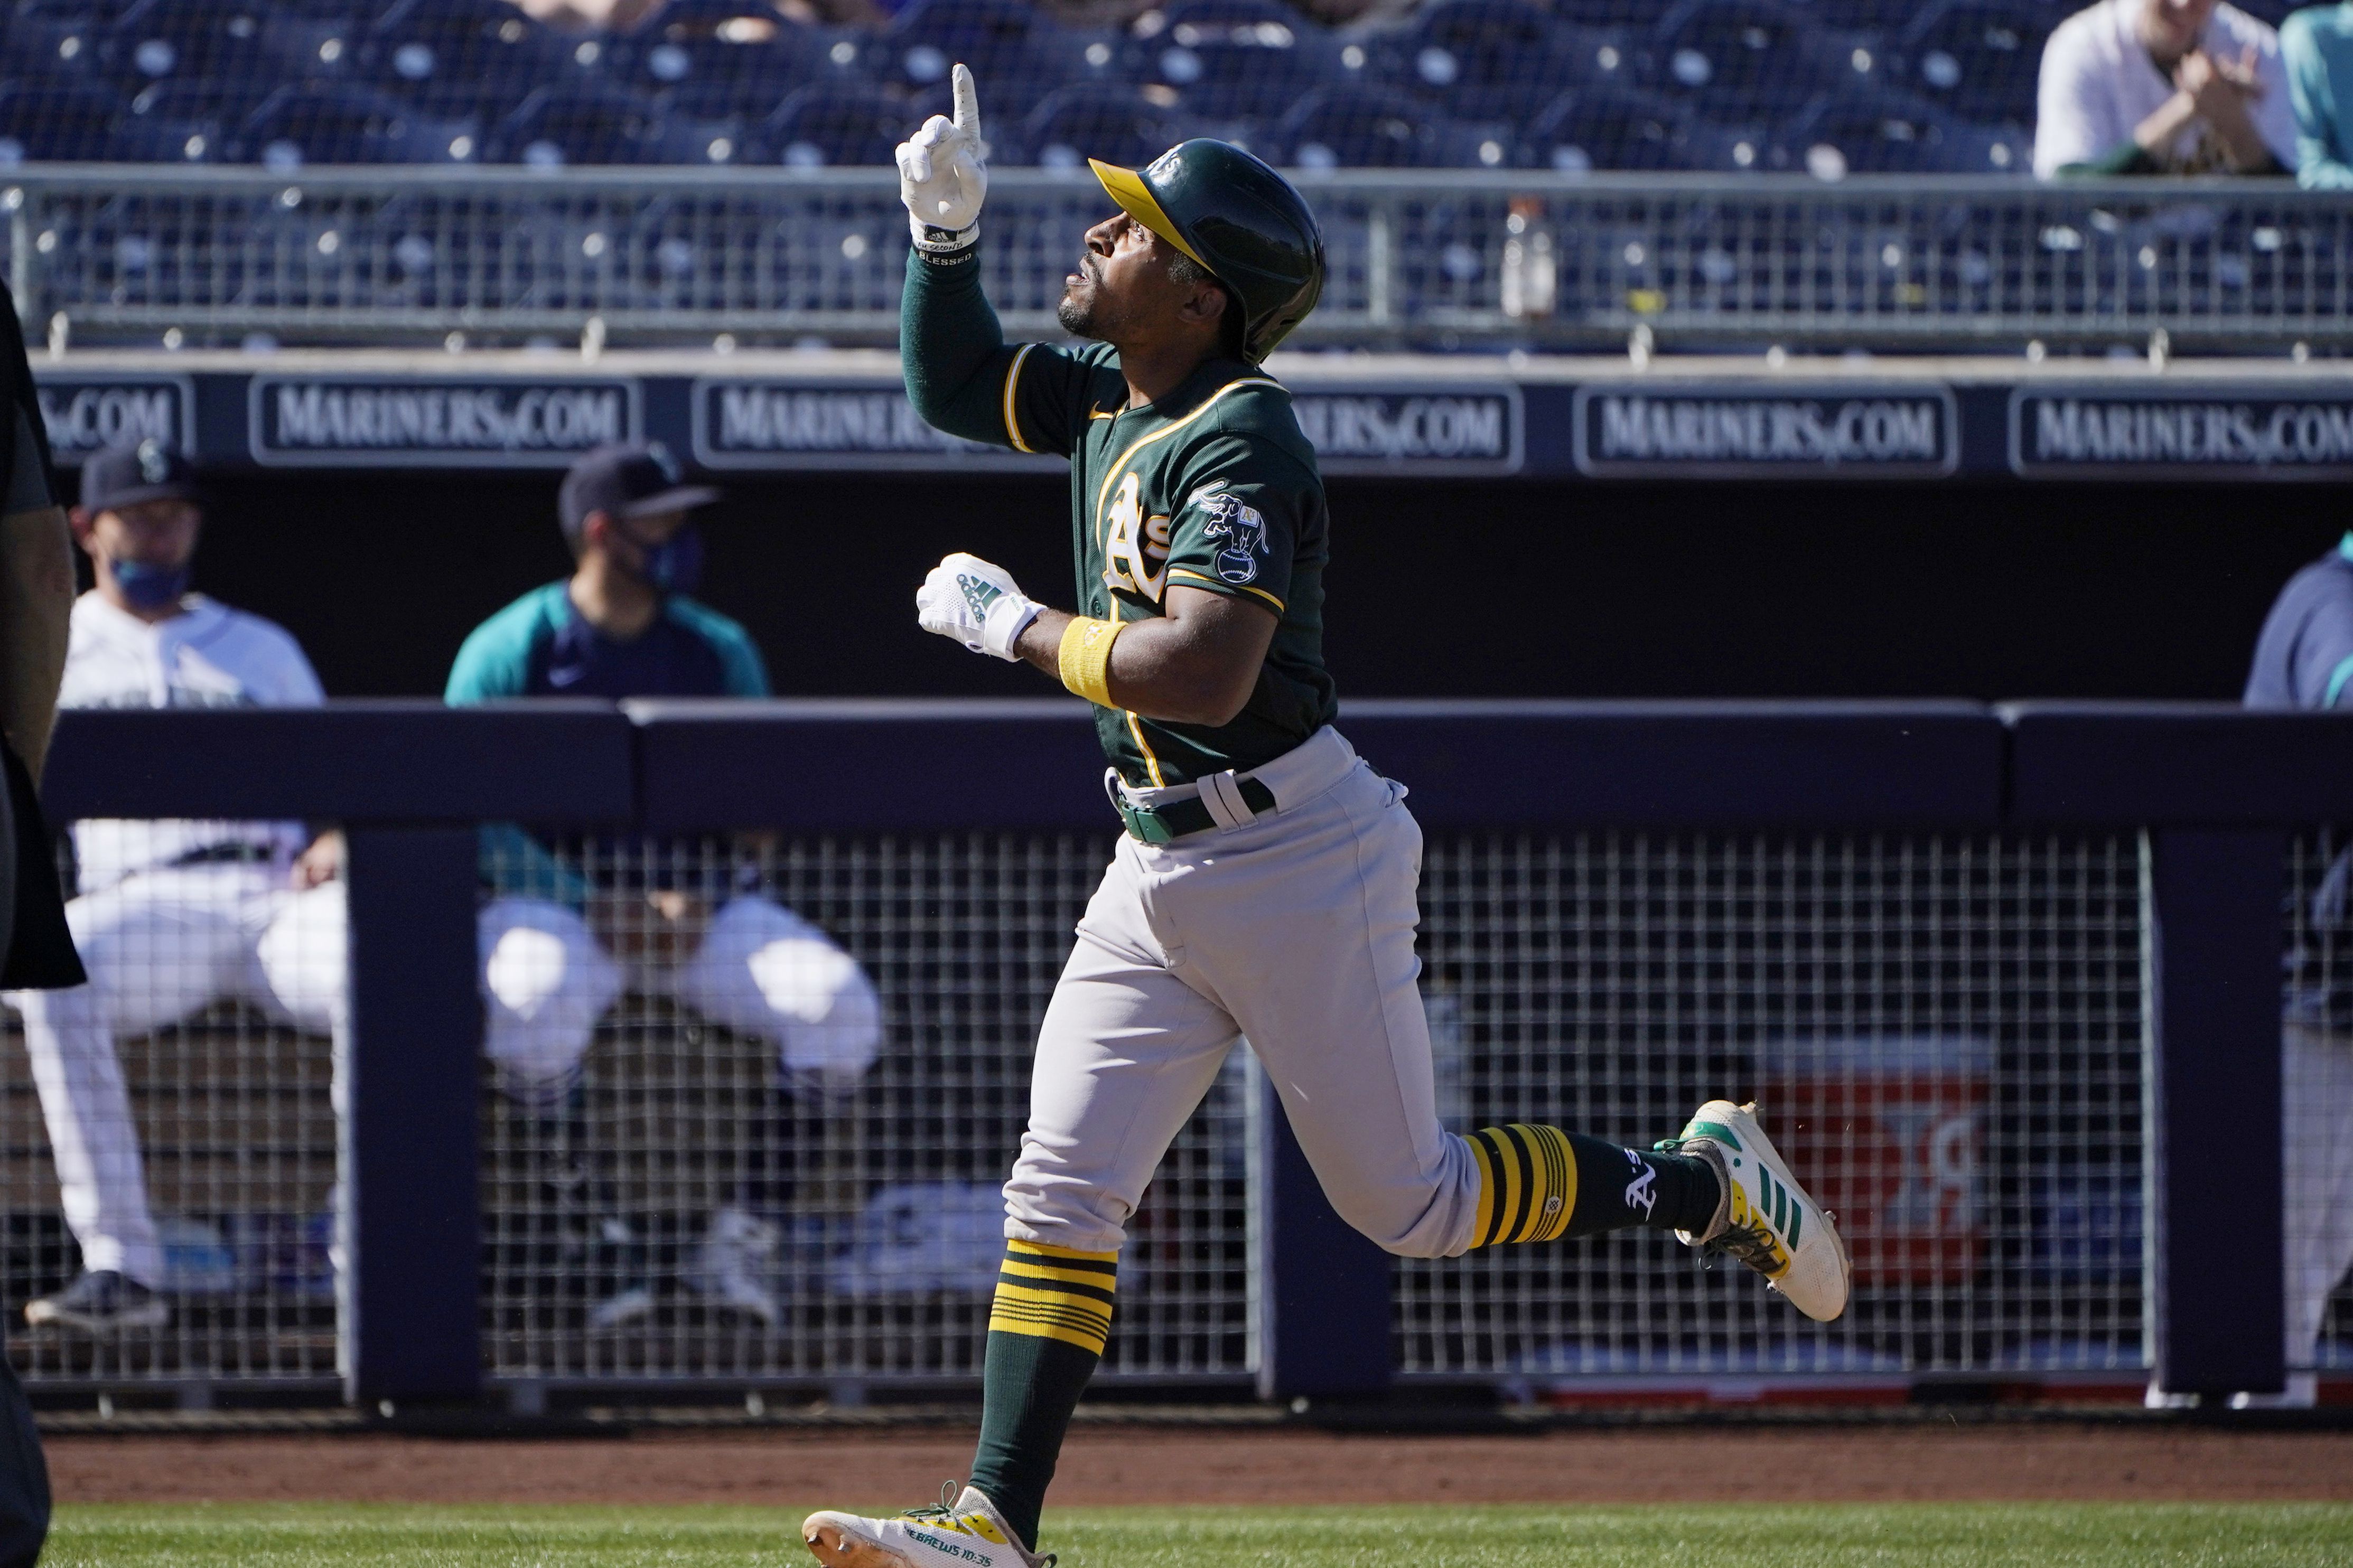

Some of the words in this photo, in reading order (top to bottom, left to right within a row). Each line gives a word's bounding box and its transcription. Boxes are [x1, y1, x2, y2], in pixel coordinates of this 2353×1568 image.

[919, 251, 972, 266] BLESSED
[956, 574, 985, 623] adidas
[961, 1548, 994, 1567] 10:35
